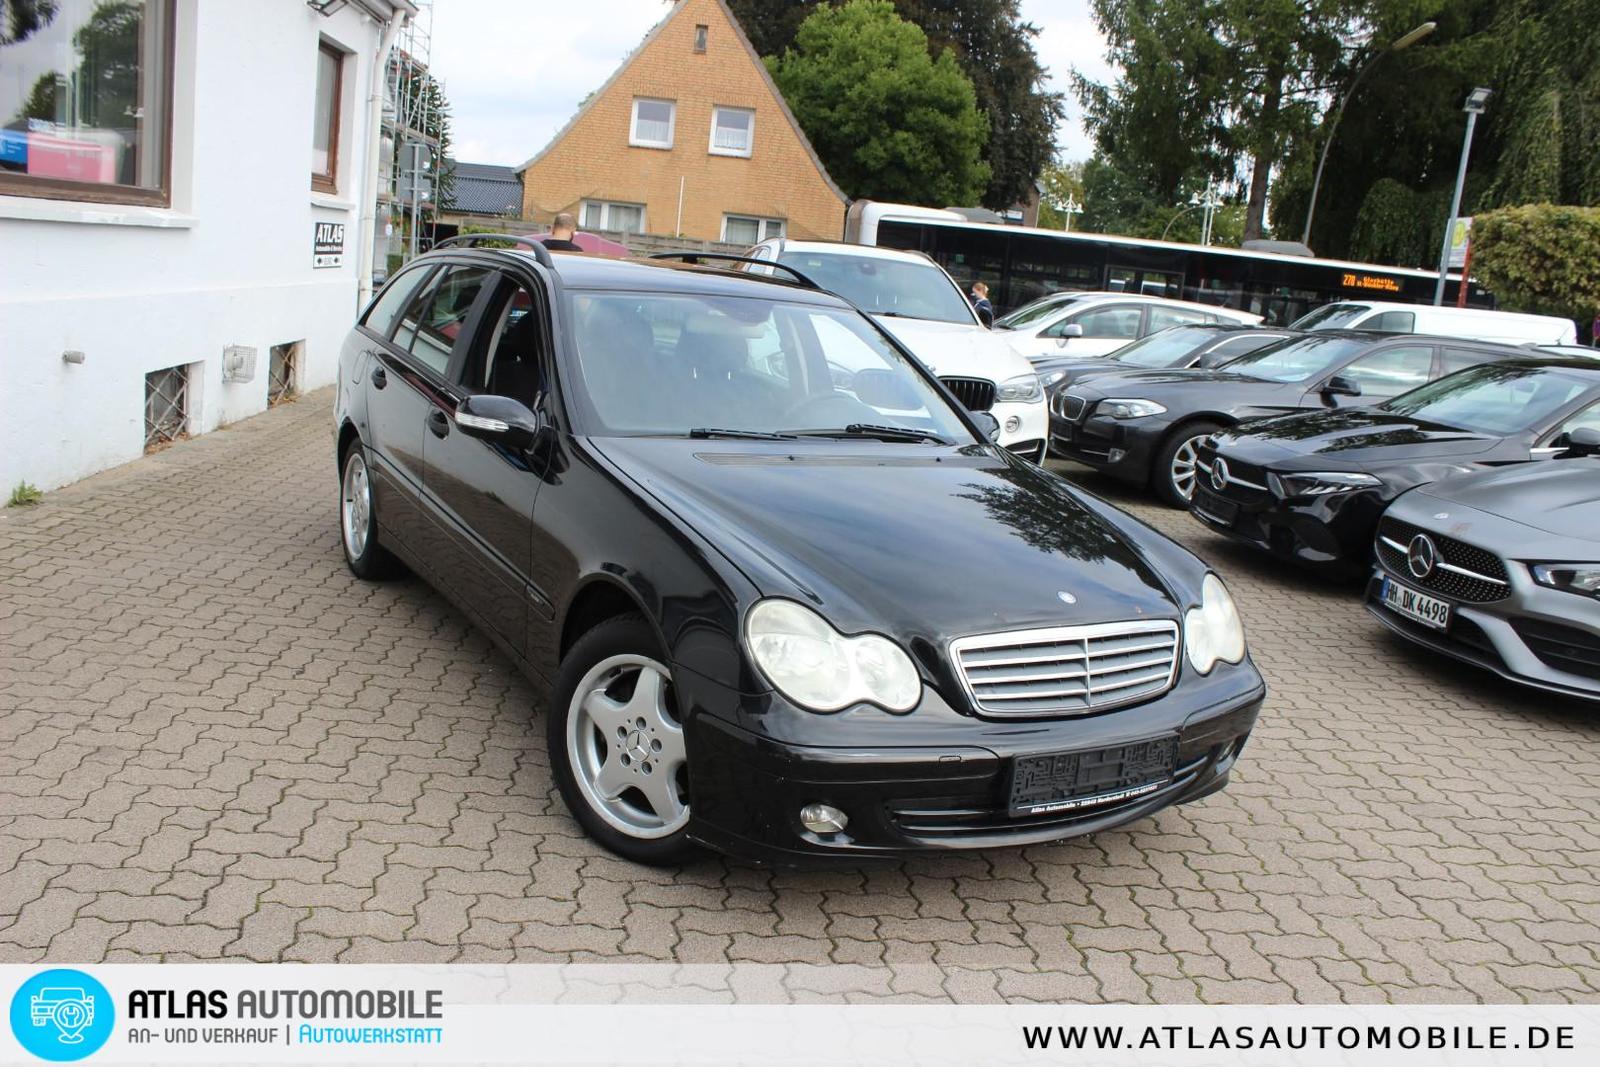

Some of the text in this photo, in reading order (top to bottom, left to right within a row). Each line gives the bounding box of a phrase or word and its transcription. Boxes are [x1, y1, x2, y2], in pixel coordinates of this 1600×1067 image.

[316, 224, 344, 243] ATLAS
[1388, 582, 1447, 623] HH DK 4498
